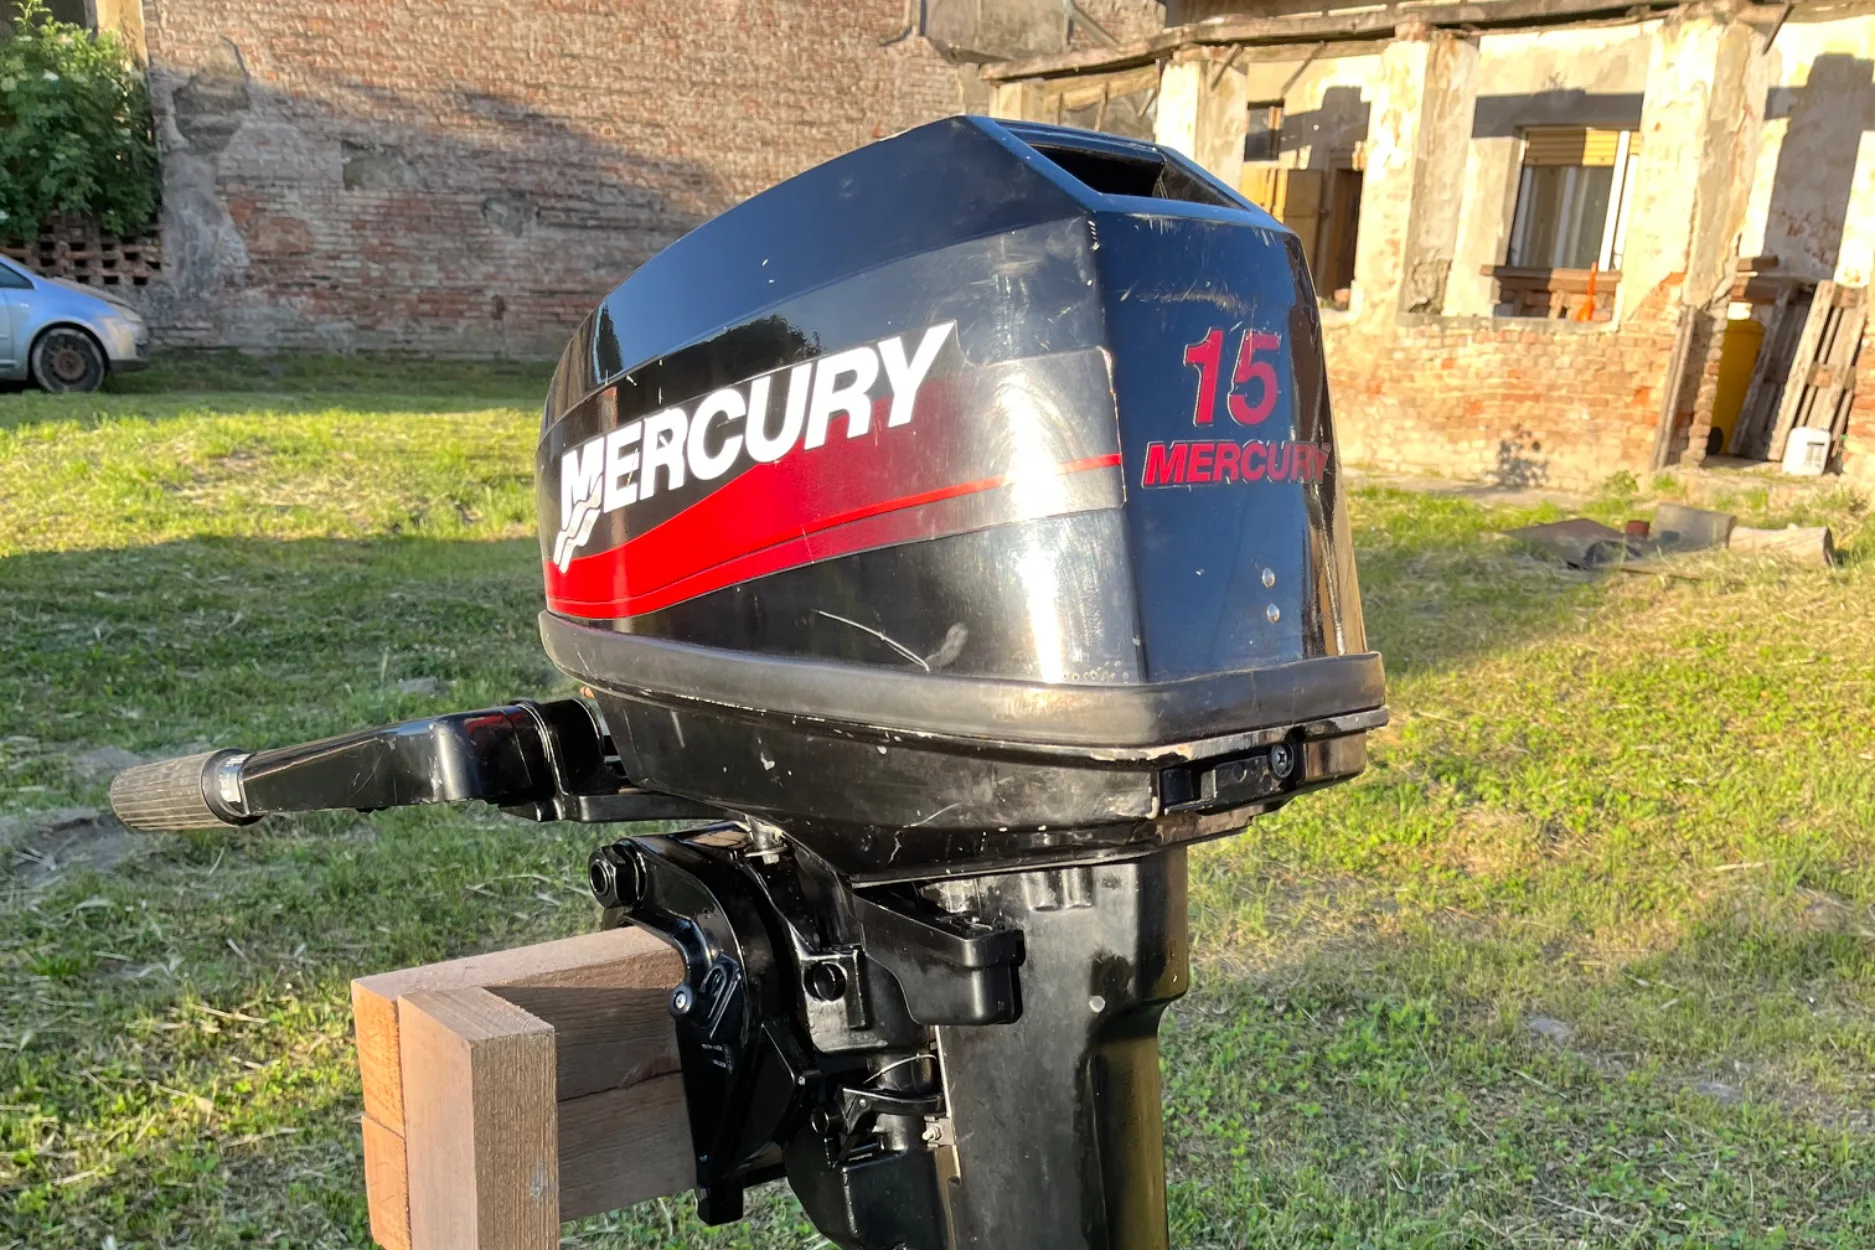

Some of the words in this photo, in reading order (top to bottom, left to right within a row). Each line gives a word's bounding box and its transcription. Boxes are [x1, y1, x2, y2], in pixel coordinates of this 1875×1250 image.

[1183, 327, 1281, 427] 15
[553, 319, 957, 573] MERCURY
[1142, 439, 1331, 489] MERCURY
